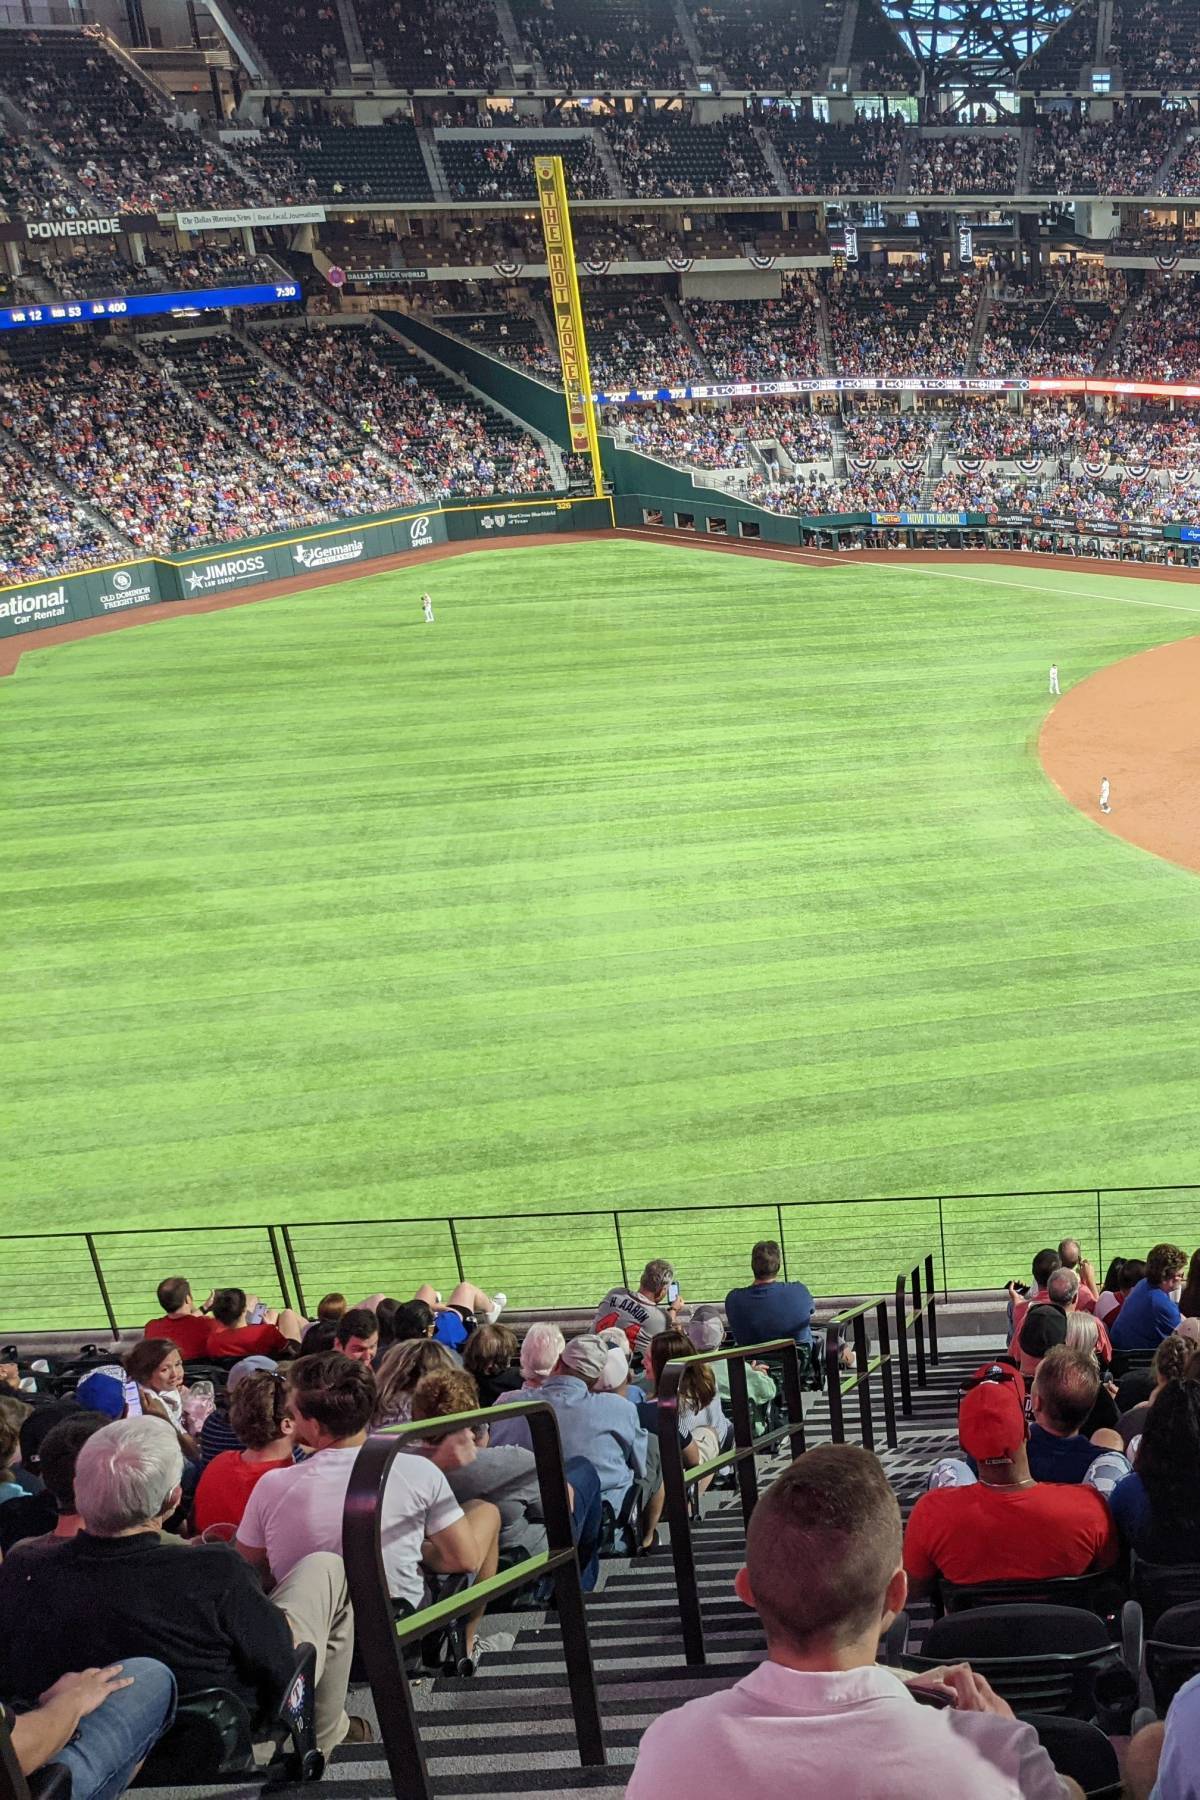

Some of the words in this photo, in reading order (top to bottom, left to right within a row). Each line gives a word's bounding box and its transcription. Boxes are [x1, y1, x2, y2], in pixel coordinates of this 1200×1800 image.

[544, 192, 559, 240] THE
[27, 218, 122, 238] POWERADE
[845, 233, 853, 256] TRULY
[959, 233, 967, 256] TRULY
[552, 255, 568, 301] HOT
[276, 286, 296, 297] 7:30
[29, 310, 42, 321] 12
[68, 307, 82, 317] 53
[108, 302, 127, 313] 400
[561, 317, 578, 379] ZONE
[907, 513, 924, 523] HOW
[926, 513, 935, 523] TO
[937, 513, 960, 523] NACHO
[314, 540, 363, 558] Germania
[412, 537, 432, 547] SPORTS
[100, 592, 115, 603] OLD
[116, 586, 150, 600] DOMINION
[104, 599, 133, 609] FREIGHT
[14, 615, 31, 625] Car
[34, 607, 65, 620] Rental
[619, 1299, 650, 1323] AARON
